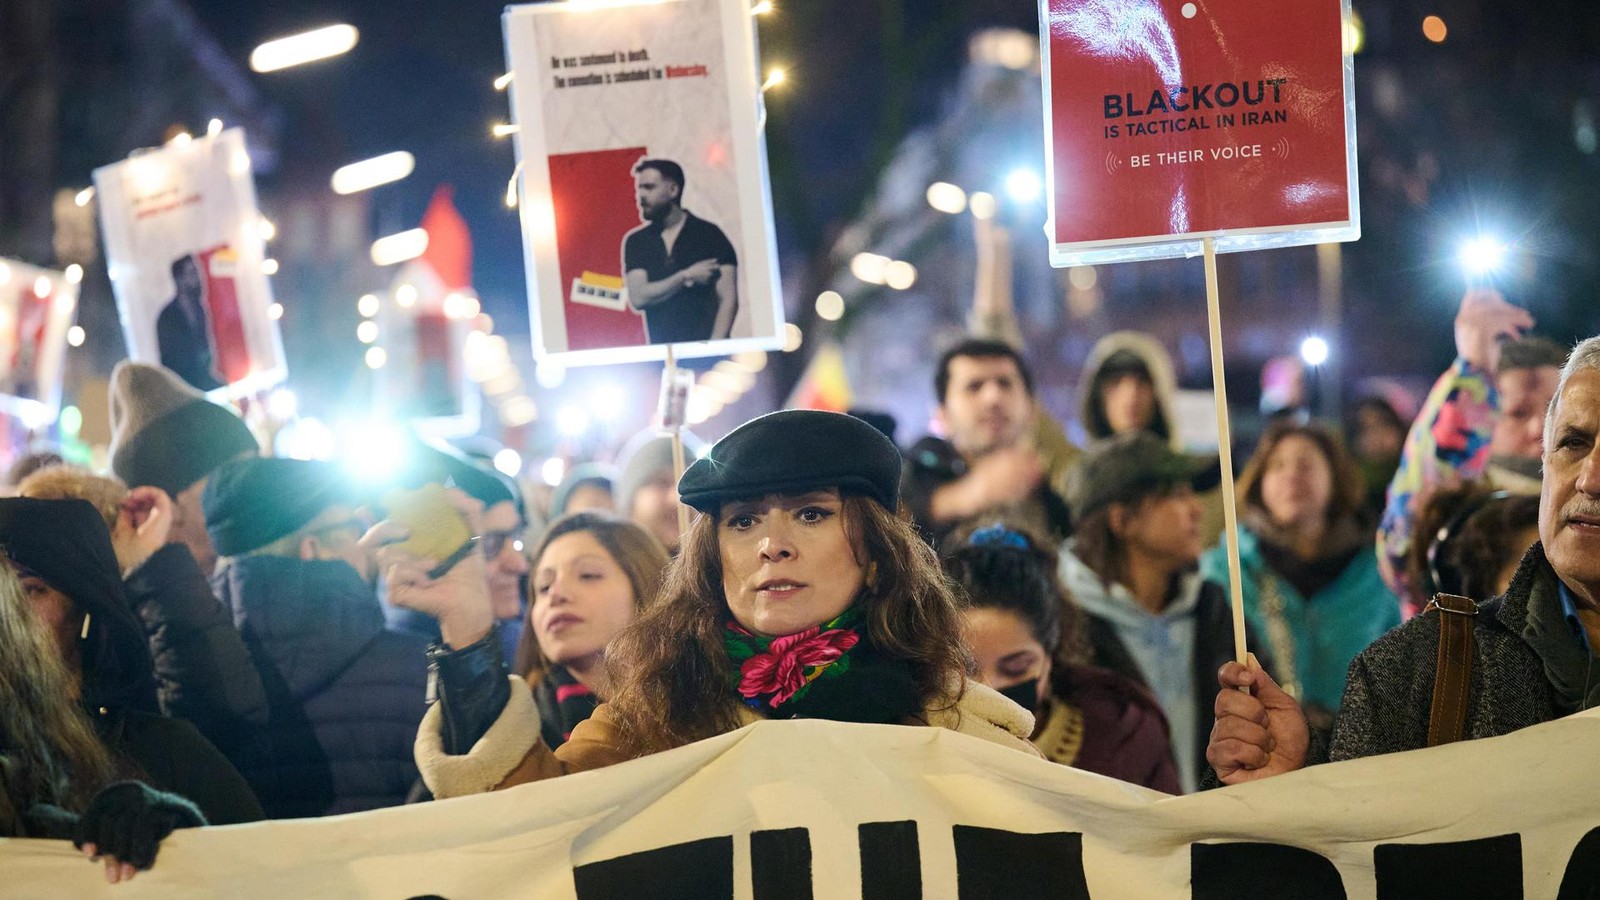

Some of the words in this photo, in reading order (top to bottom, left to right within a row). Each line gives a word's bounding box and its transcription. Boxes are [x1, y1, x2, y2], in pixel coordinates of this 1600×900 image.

[1103, 78, 1288, 119] BLACKOUT
[1104, 124, 1119, 139] IS
[1126, 118, 1210, 136] TACTICAL
[1216, 113, 1235, 128] IN
[1242, 109, 1287, 125] IRAN
[1130, 154, 1151, 168] BE
[1157, 149, 1204, 165] THEIR
[1210, 144, 1262, 160] VOICE
